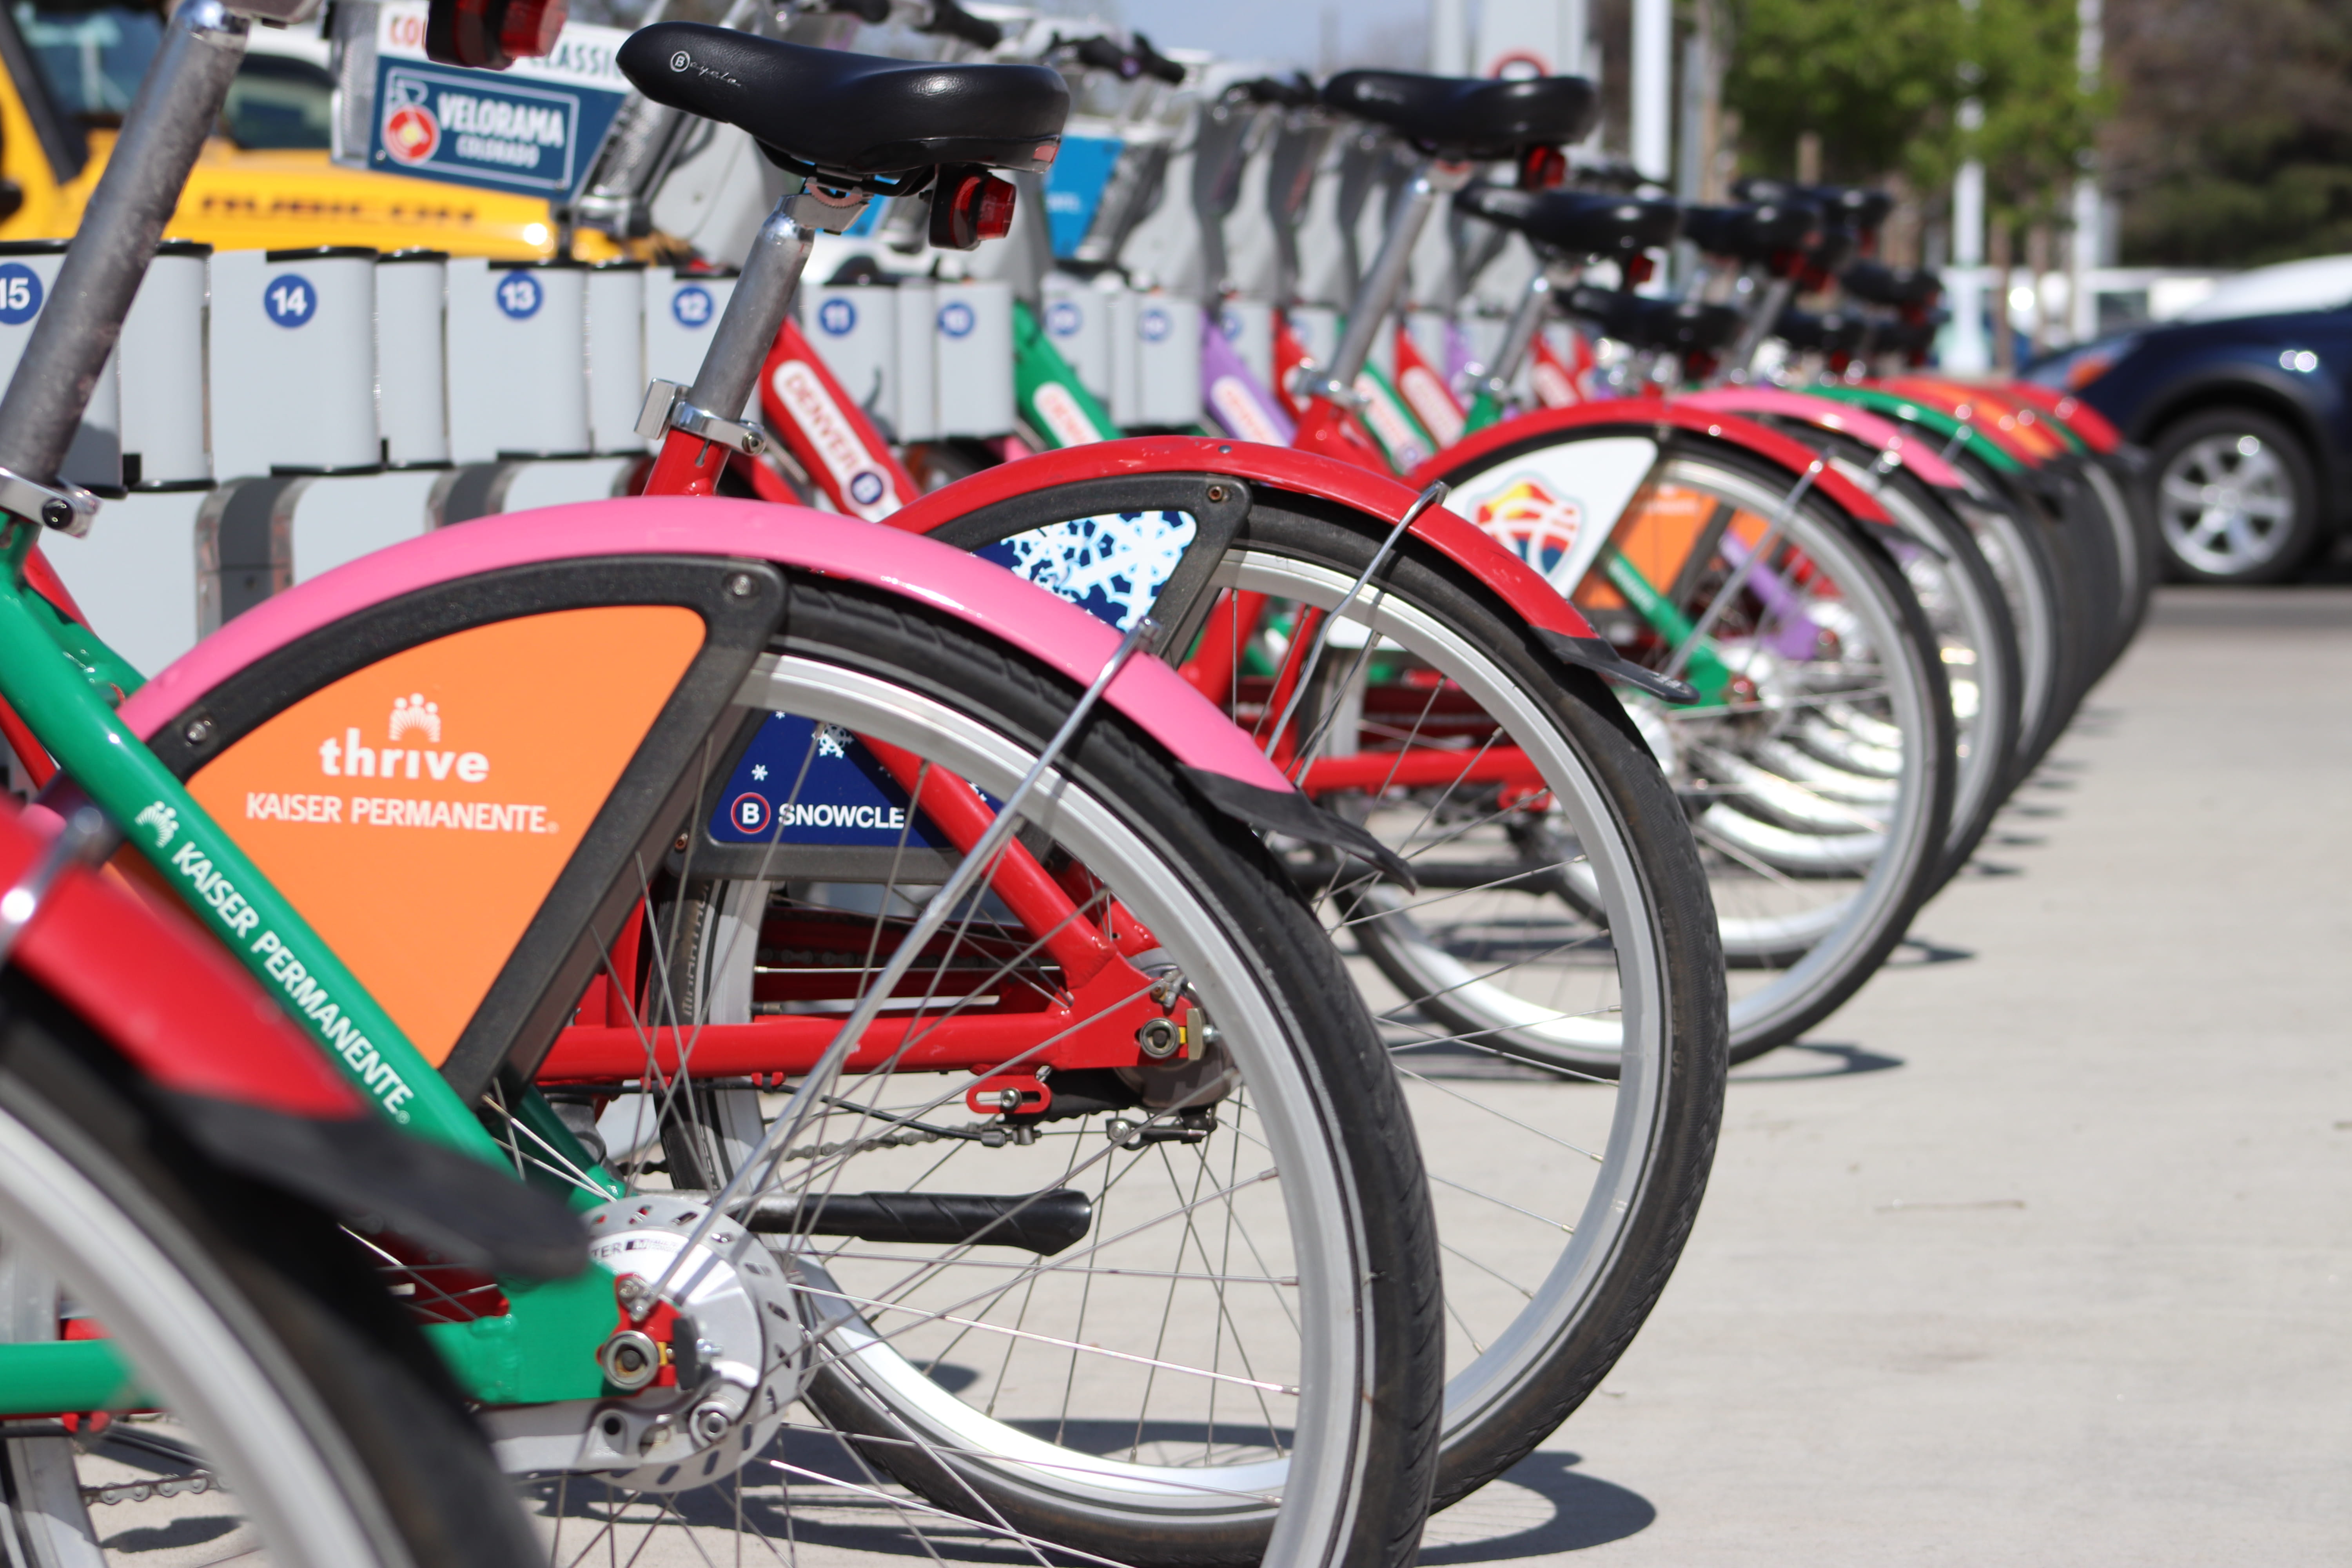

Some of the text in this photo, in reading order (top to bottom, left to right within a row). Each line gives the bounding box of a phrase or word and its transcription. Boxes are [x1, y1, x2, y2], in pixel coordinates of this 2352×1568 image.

[436, 91, 565, 148] VELORAMA
[0, 277, 31, 310] 15
[271, 285, 308, 317] 14
[501, 281, 535, 311] 13
[677, 292, 708, 320] 12
[784, 372, 862, 473] DENVER
[319, 726, 490, 782] thrive
[245, 791, 342, 823] KAISER
[171, 840, 260, 940] KAISER
